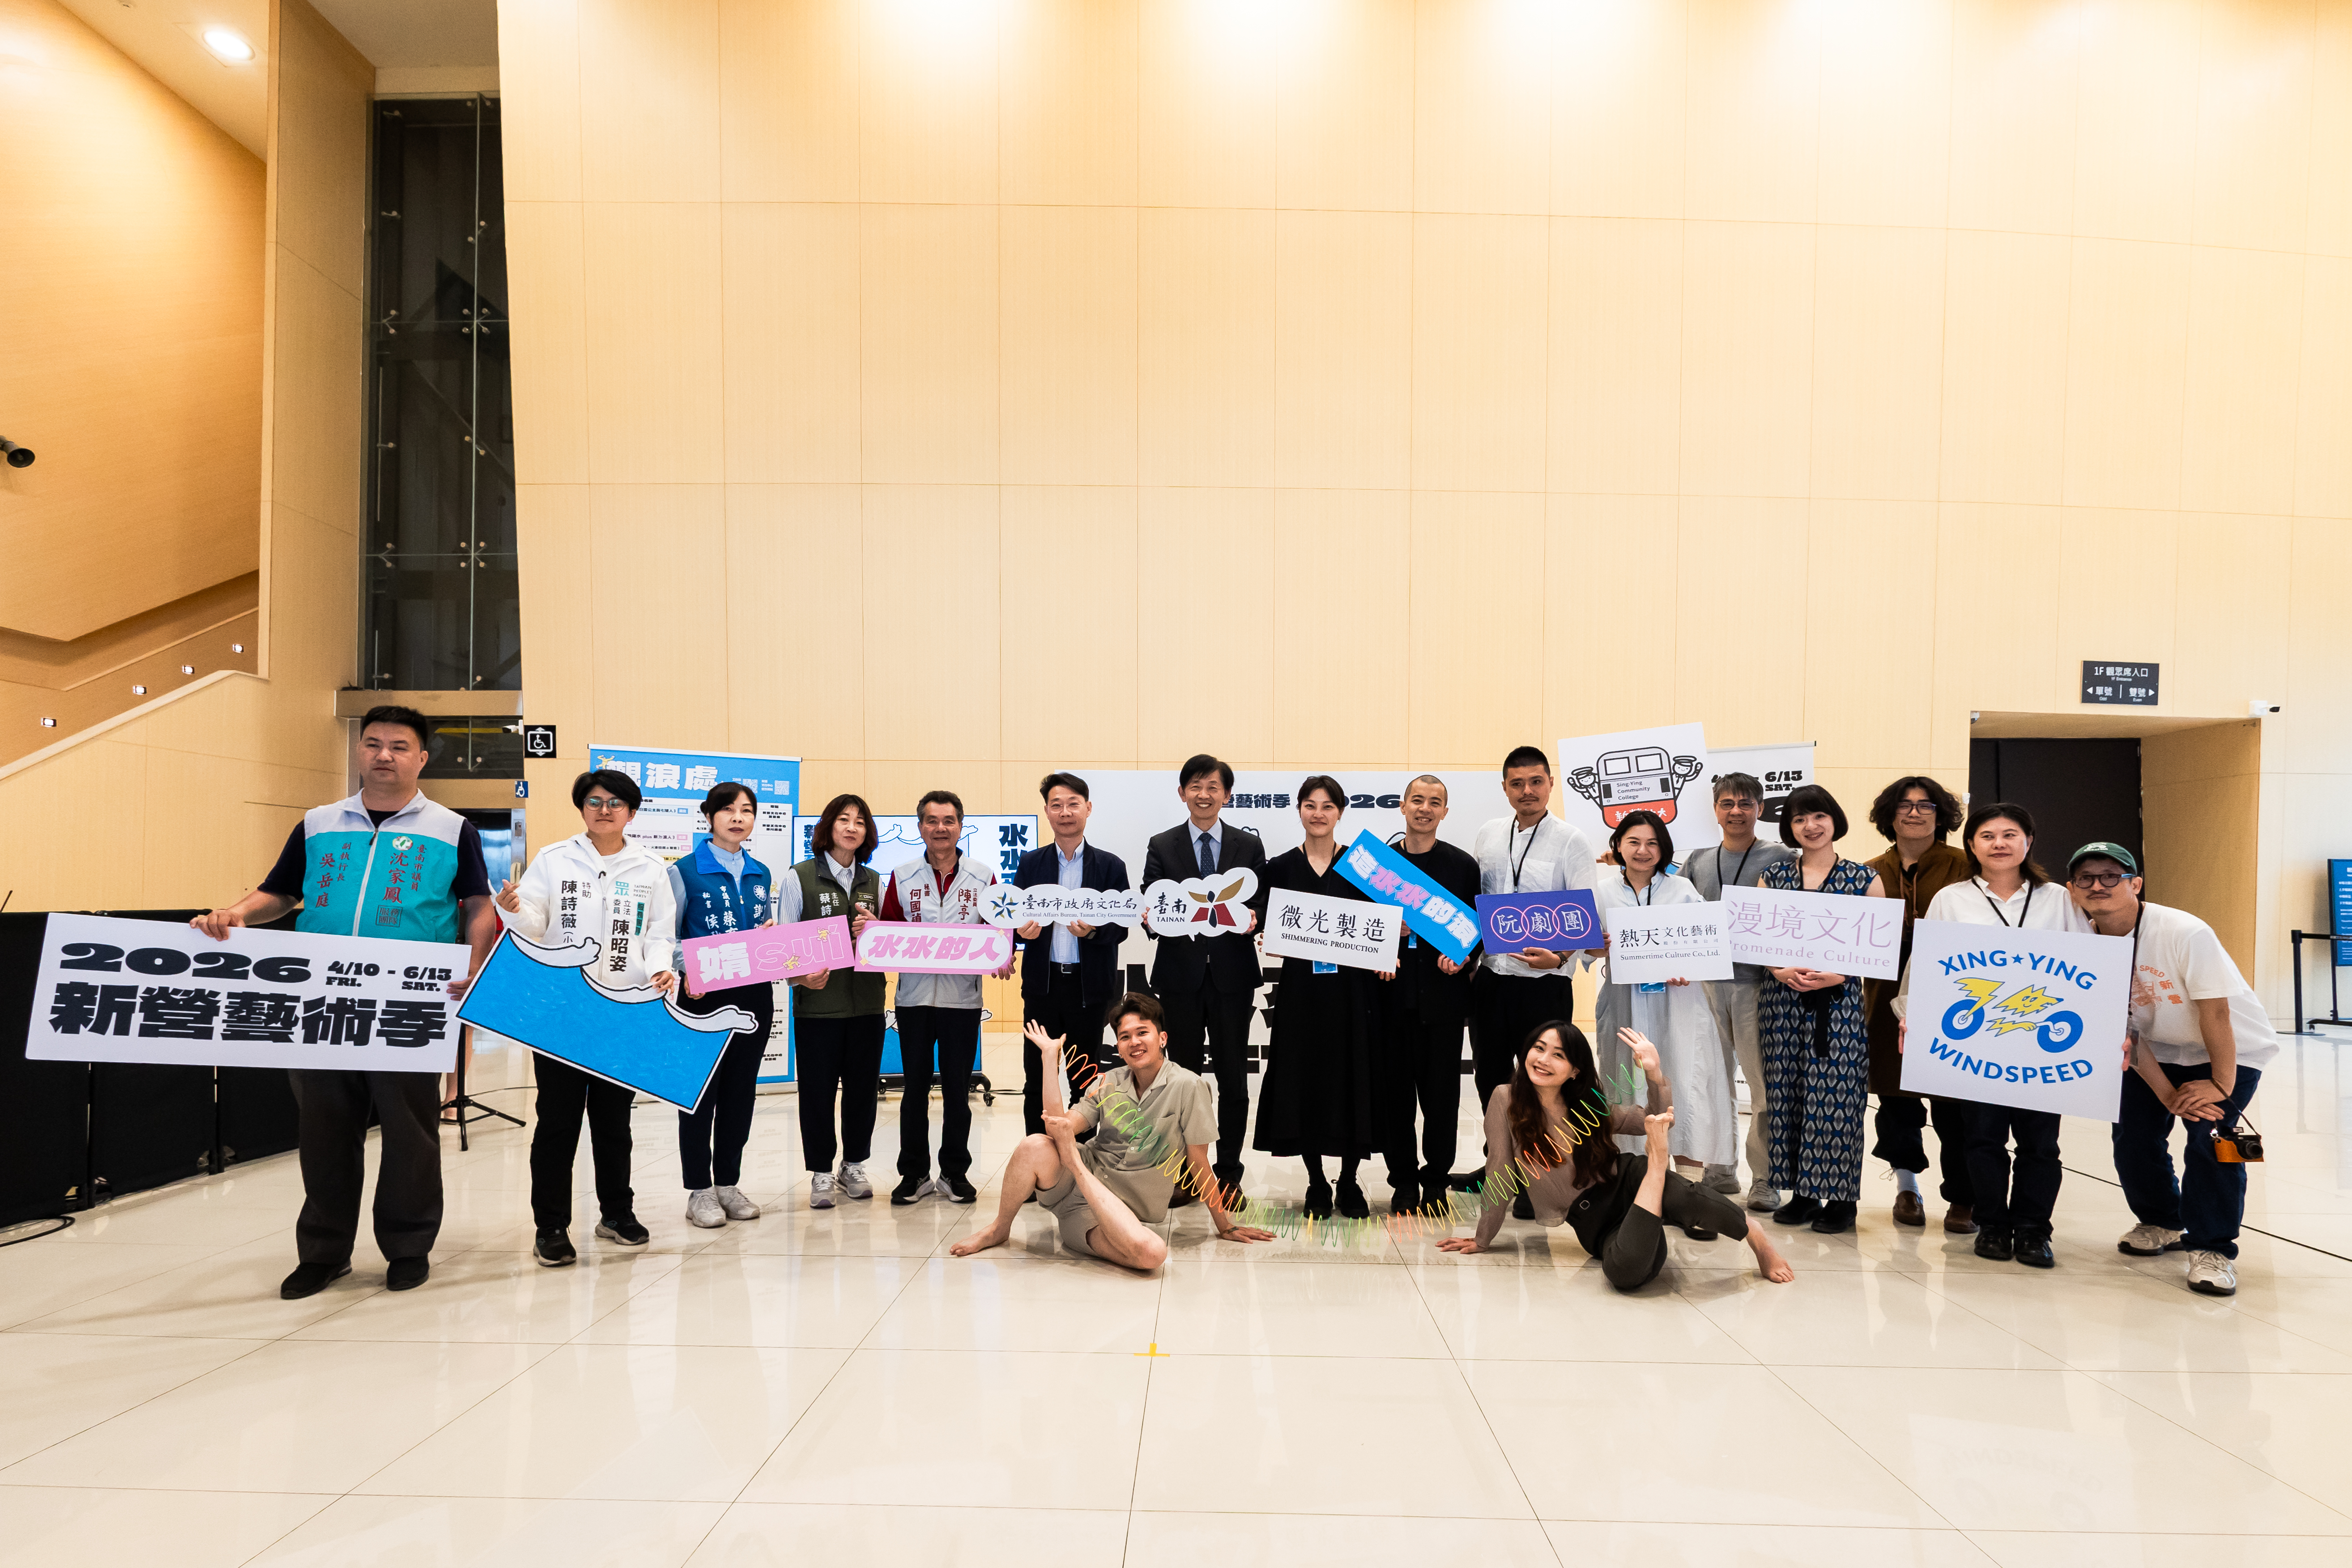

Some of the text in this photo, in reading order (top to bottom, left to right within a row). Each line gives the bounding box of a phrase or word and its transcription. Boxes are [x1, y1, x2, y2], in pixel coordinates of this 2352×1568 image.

[2094, 667, 2148, 677] 1F 觀眾席入口
[1765, 770, 1802, 782] 6/13
[1615, 808, 1667, 822] 新大
[337, 842, 351, 882] 副執行長
[315, 853, 336, 908] 吳岳庭
[382, 852, 409, 904] 沈家鳳
[582, 882, 592, 898] 特助
[831, 892, 839, 906] 主任
[958, 888, 971, 924] 陳亭
[1023, 894, 1137, 911] 臺南市政府文化局
[1154, 892, 1187, 914] 臺南
[1278, 904, 1386, 942] 微光製造
[1496, 909, 1584, 934] 阮劇團
[1728, 900, 1891, 948] 漫境文化
[609, 920, 630, 972] 陳昭姿
[868, 934, 1000, 962] 水水的人
[1281, 933, 1379, 954] SHIMMERING PRODUCTION
[1730, 940, 1891, 967] romenade Culture
[59, 942, 312, 984] 2026
[328, 960, 380, 976] 4/10
[403, 966, 452, 981] 6/13
[2139, 965, 2165, 977] SPEED
[326, 976, 441, 992] FRI. SAT.
[48, 980, 448, 1048] 新營藝術季
[1929, 1037, 2093, 1084] WINDSPEED
